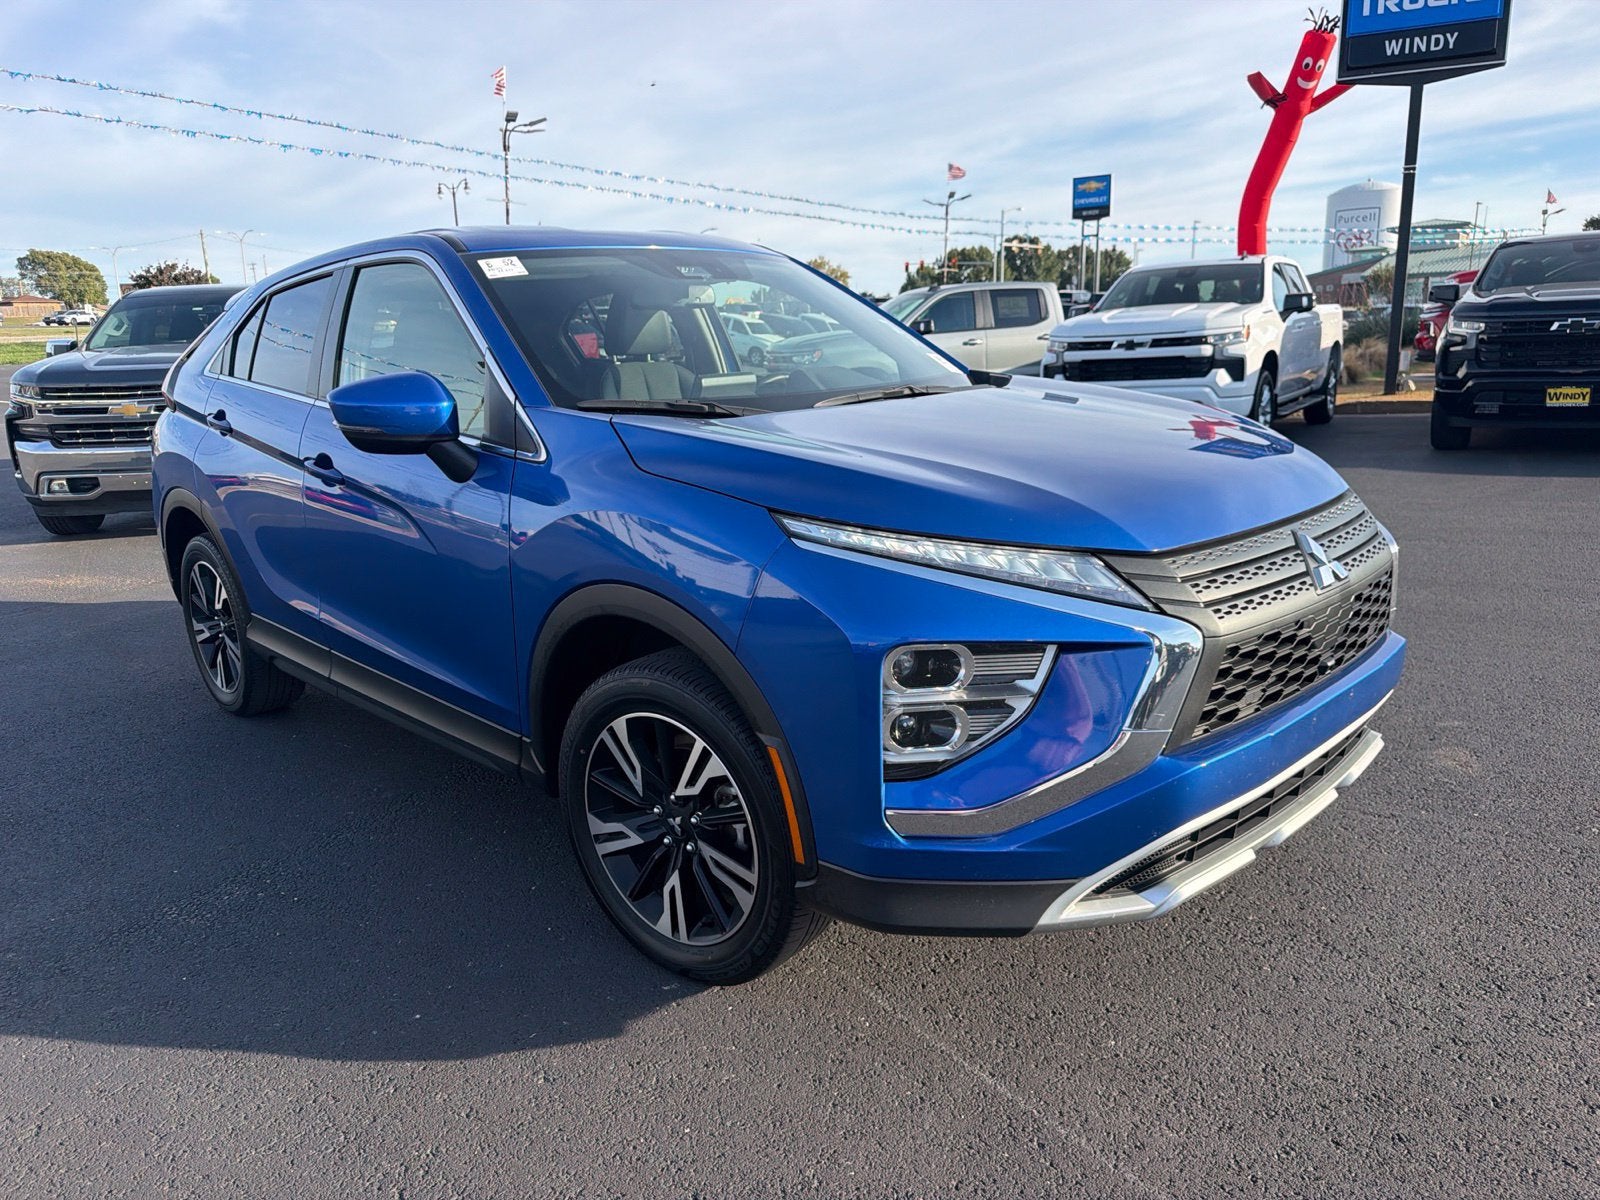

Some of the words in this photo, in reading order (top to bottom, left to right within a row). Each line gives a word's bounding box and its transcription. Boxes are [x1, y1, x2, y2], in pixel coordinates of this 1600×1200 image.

[1385, 32, 1459, 56] WINDY
[1338, 212, 1377, 224] Purcell
[1547, 391, 1589, 401] WINDY
